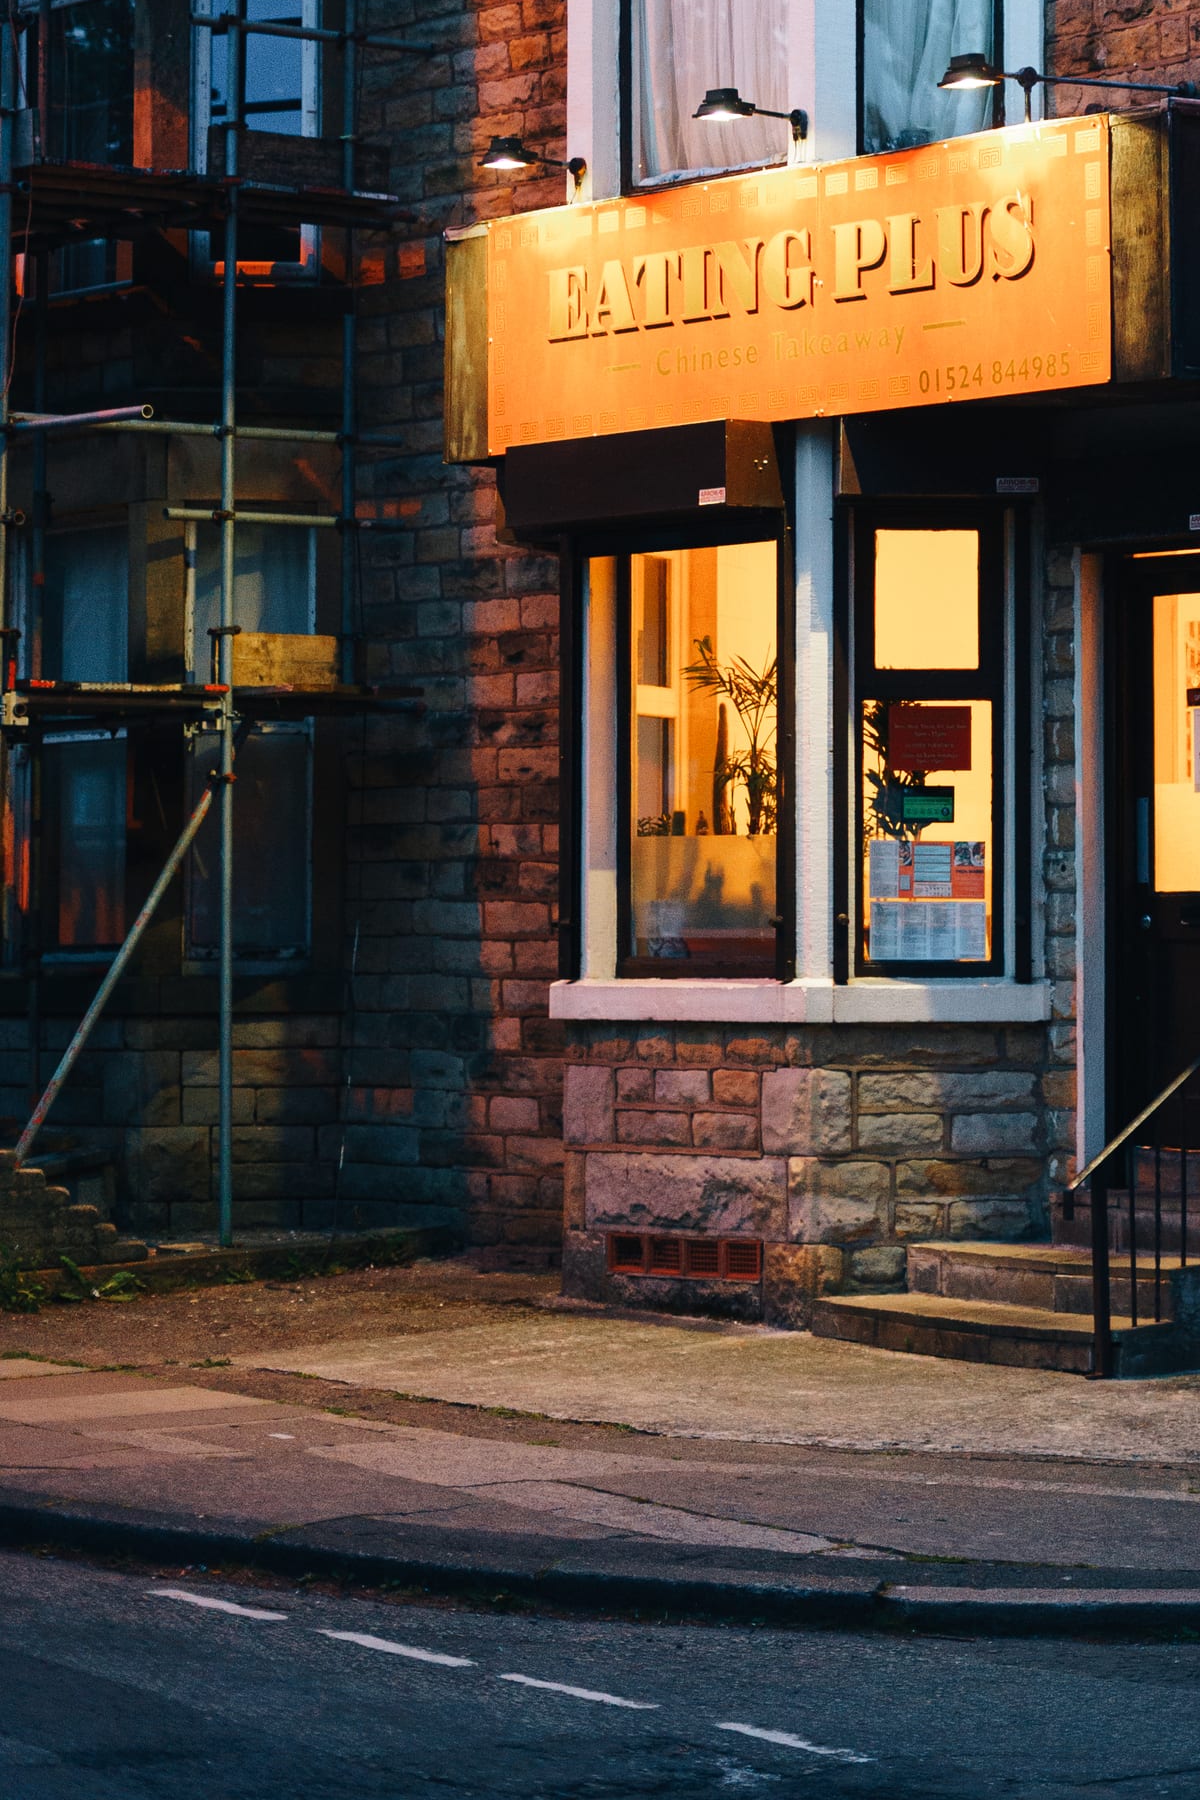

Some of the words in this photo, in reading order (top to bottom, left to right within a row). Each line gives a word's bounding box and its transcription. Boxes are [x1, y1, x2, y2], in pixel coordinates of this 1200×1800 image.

[548, 227, 817, 342] EATING
[830, 192, 1036, 304] PLUS
[655, 345, 759, 376] Chinese
[771, 326, 906, 362] Takeaway
[918, 363, 984, 394] 01524
[991, 351, 1071, 385] 844985
